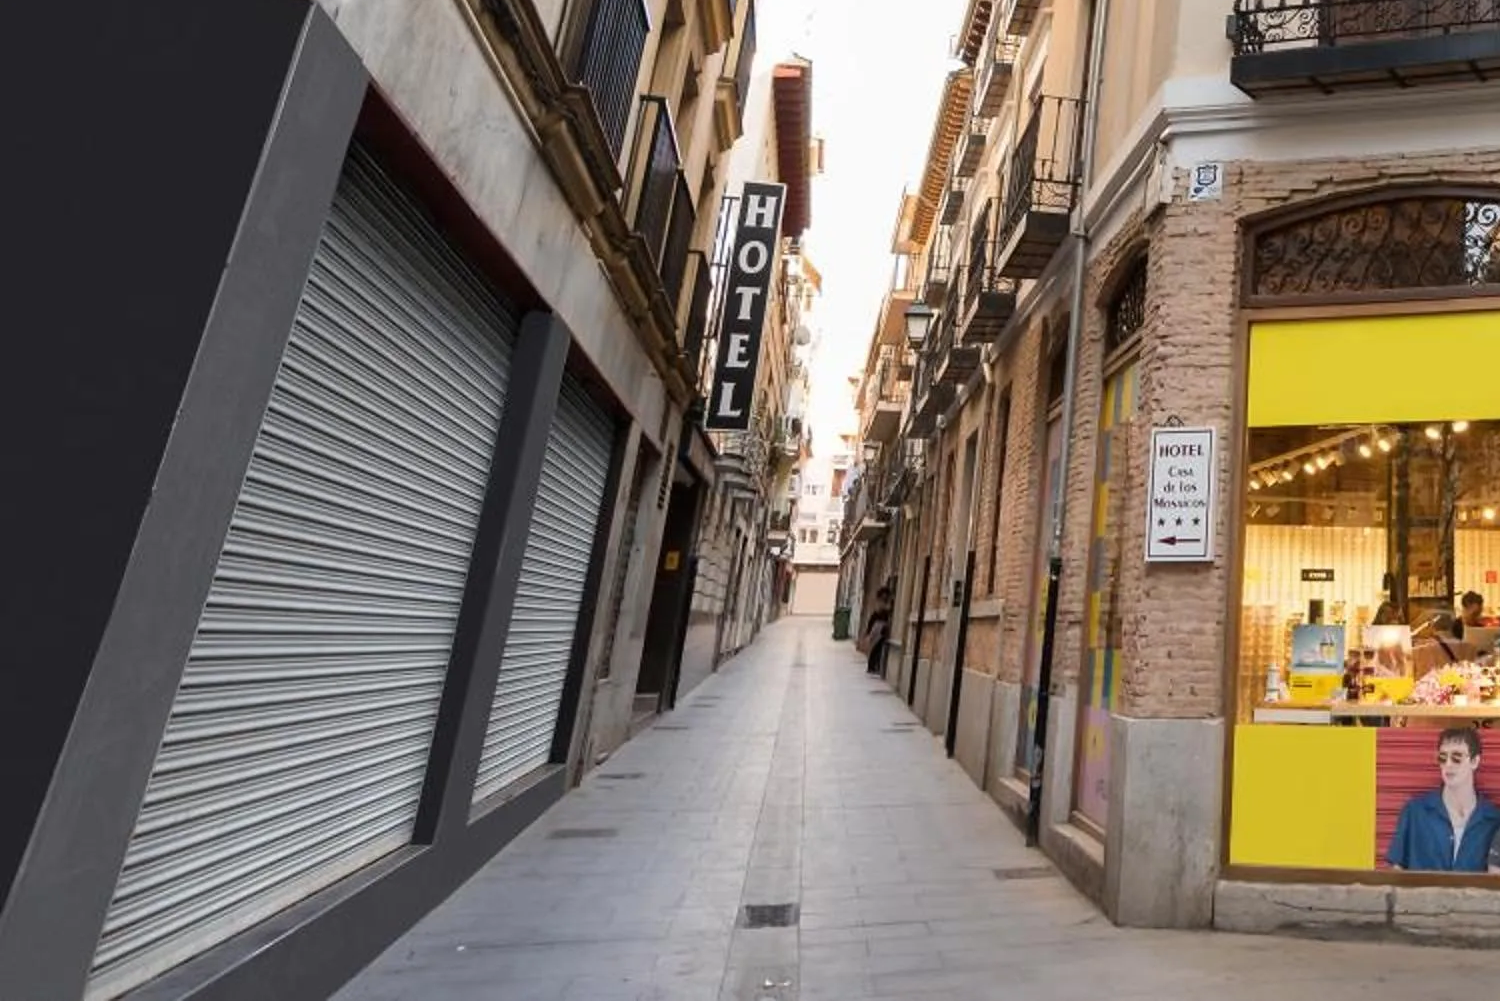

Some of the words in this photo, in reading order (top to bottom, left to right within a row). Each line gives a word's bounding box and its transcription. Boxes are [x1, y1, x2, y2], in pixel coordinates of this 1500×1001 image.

[716, 194, 778, 417] HOTEL
[1158, 444, 1204, 457] HOTEL
[1168, 466, 1194, 478] Casa
[1179, 481, 1197, 493] los
